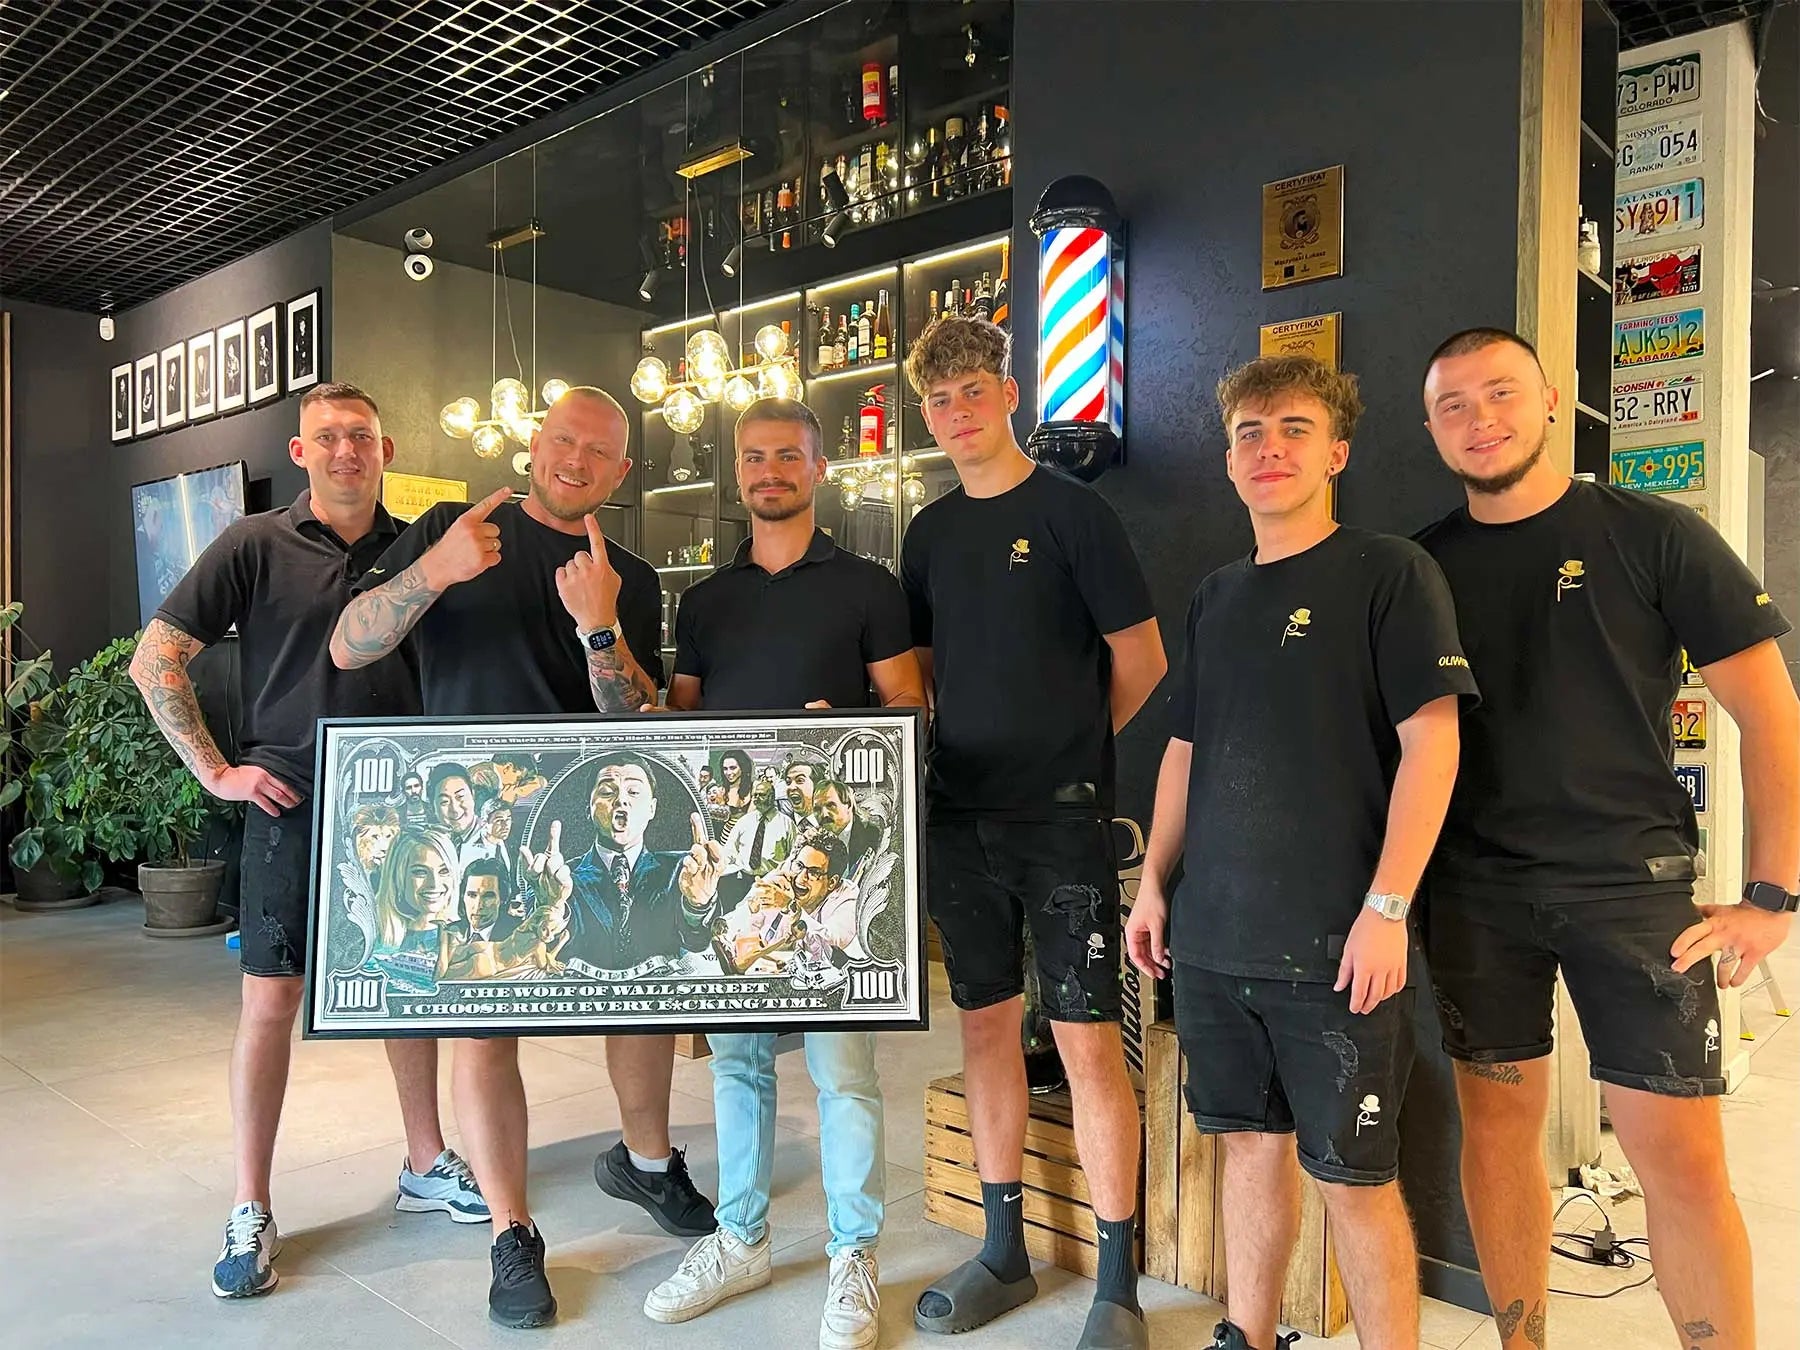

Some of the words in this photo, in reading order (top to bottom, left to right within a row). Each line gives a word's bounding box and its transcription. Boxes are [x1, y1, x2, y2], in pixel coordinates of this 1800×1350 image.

[1620, 97, 1673, 115] COLORADO
[1660, 129, 1697, 158] 054
[1629, 162, 1664, 176] RANKIN
[1274, 172, 1327, 192] CERTYFIKAT
[1623, 188, 1672, 204] ALASKA
[1616, 204, 1639, 233] SY
[1655, 192, 1694, 225] 911
[1272, 319, 1324, 334] CERTYFIKAT
[1620, 319, 1654, 331] FARMING
[1656, 314, 1679, 325] FEEDS
[1619, 321, 1699, 357] AJK512
[1621, 350, 1678, 365] ALABAMA
[1614, 387, 1692, 422] 52-RRY
[1612, 459, 1637, 484] NZ
[1663, 451, 1703, 479] 995
[1644, 479, 1680, 488] MEXICO
[353, 758, 394, 793] 100
[844, 748, 884, 784] 100
[336, 979, 378, 1009] 100
[460, 987, 510, 999] THE
[513, 986, 577, 999] WOLF
[579, 985, 608, 997] OF
[611, 984, 675, 996] WALL
[676, 982, 769, 995] STREET
[851, 970, 893, 1000] 100
[401, 1004, 413, 1015] I
[414, 1003, 510, 1015] CHOOSE
[512, 1001, 577, 1014] RICH
[580, 999, 656, 1013] EVERY
